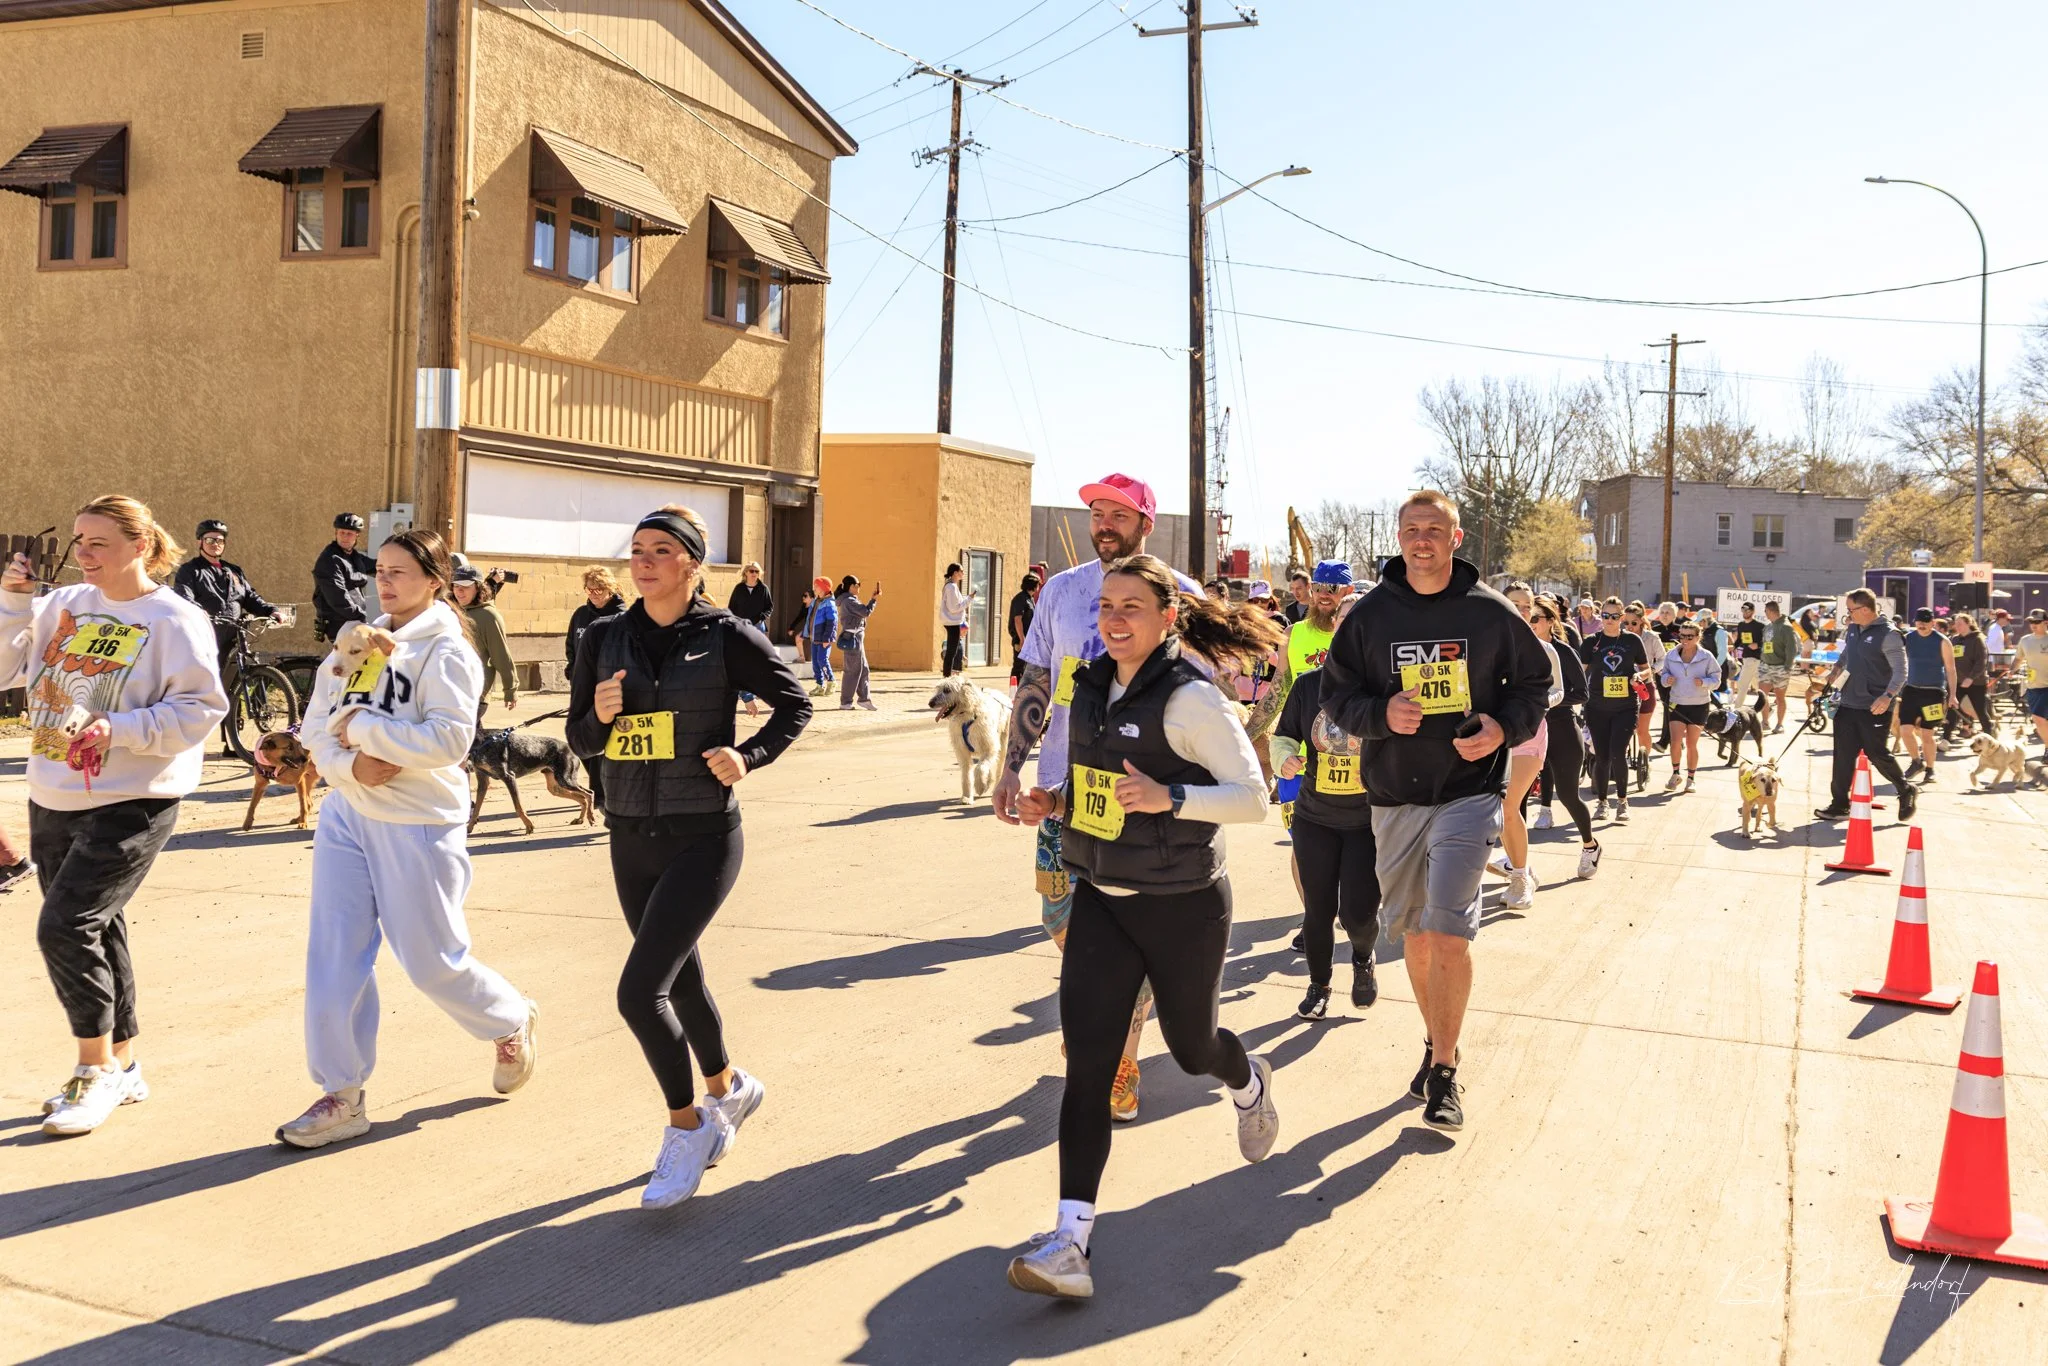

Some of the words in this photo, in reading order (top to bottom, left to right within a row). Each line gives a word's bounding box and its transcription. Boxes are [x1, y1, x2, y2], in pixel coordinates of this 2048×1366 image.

[1972, 570, 1984, 578] NO
[1726, 592, 1748, 601] ROAD
[1752, 593, 1783, 604] CLOSED
[115, 626, 131, 637] 5K
[86, 638, 120, 657] 136
[1397, 643, 1460, 665] SMR
[1437, 665, 1451, 676] 5K
[1421, 680, 1451, 699] 476
[1609, 683, 1624, 692] 335
[637, 716, 654, 728] 5K
[617, 734, 653, 756] 281
[1340, 758, 1351, 767] 5K
[1098, 774, 1111, 789] 5K
[1328, 769, 1350, 783] 477
[1085, 791, 1107, 818] 179
